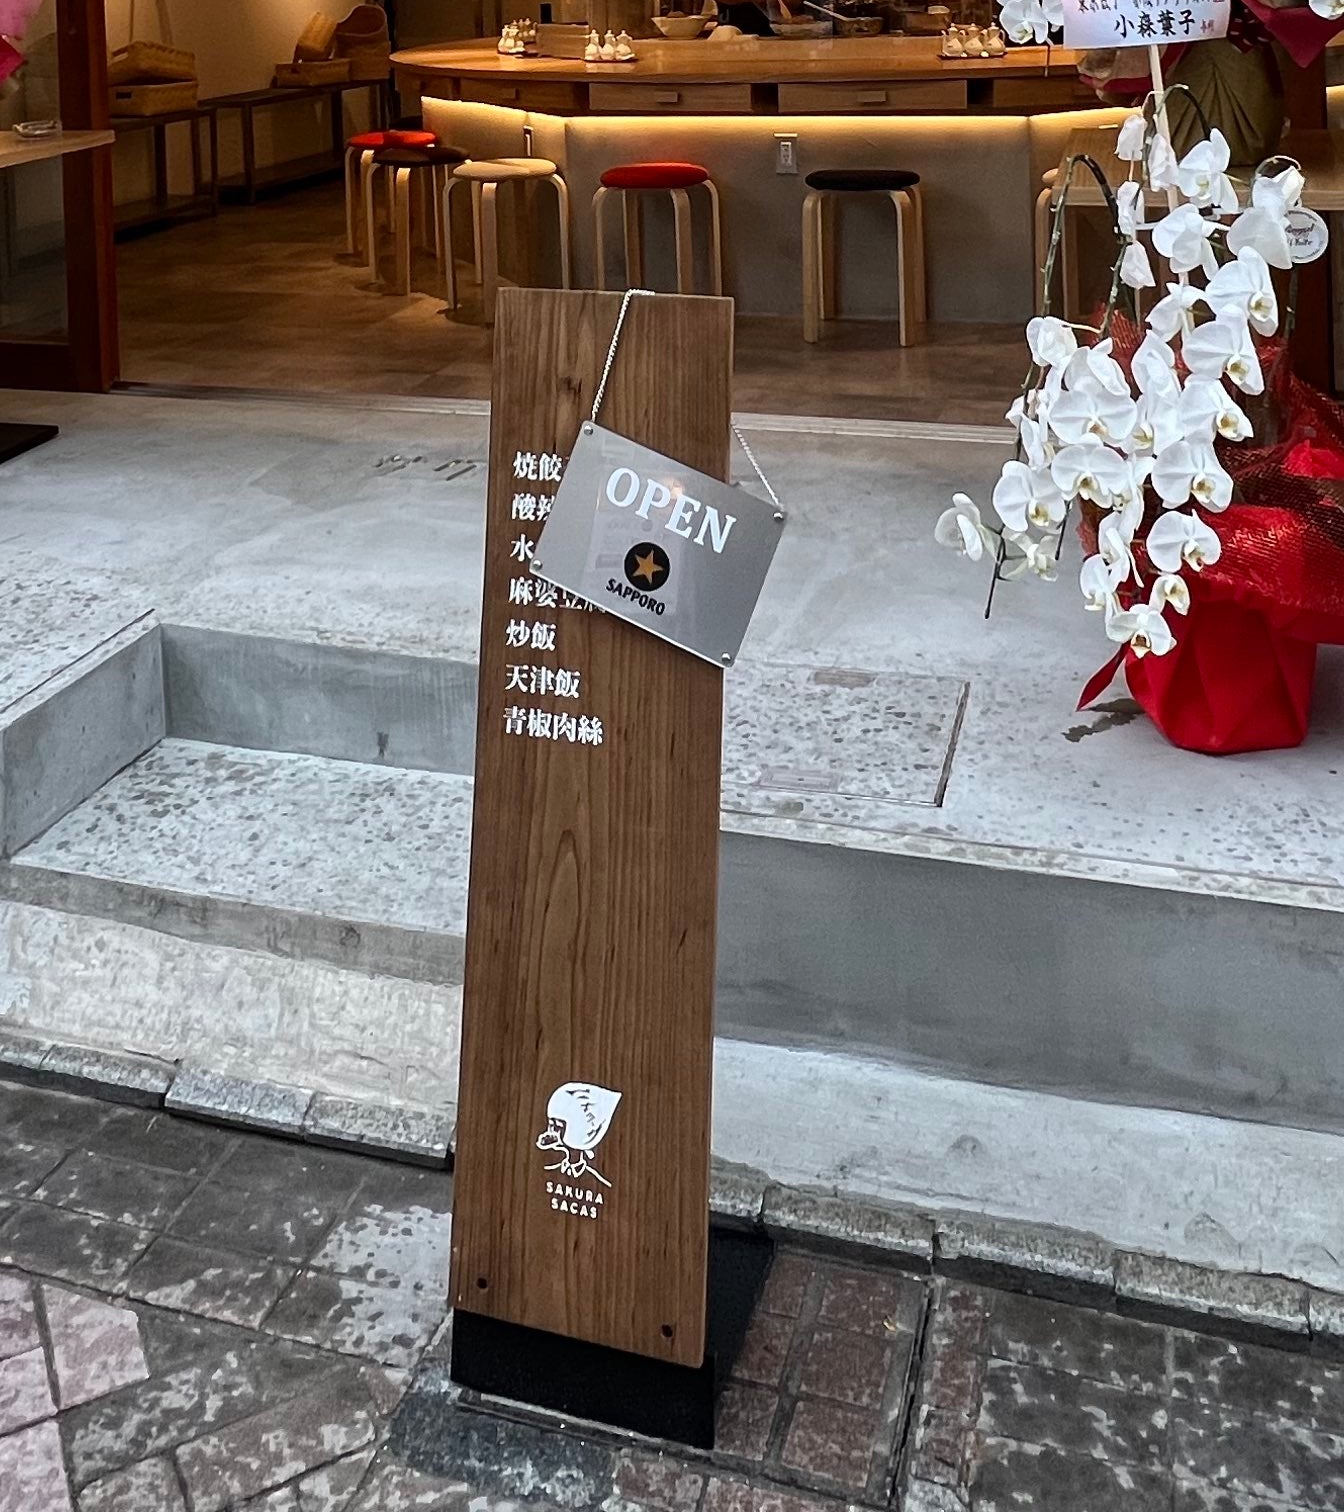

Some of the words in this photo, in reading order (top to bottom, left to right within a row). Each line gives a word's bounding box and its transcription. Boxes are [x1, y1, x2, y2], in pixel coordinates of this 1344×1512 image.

[513, 450, 570, 482] 焼餃
[606, 467, 737, 555] OPEN
[605, 578, 666, 616] SAPPORO
[506, 619, 557, 651] 炒飯
[505, 663, 581, 699] 天津飯
[502, 705, 604, 746] 青椒肉絲
[547, 1182, 604, 1205] SAKURA
[551, 1198, 598, 1220] SACAS
